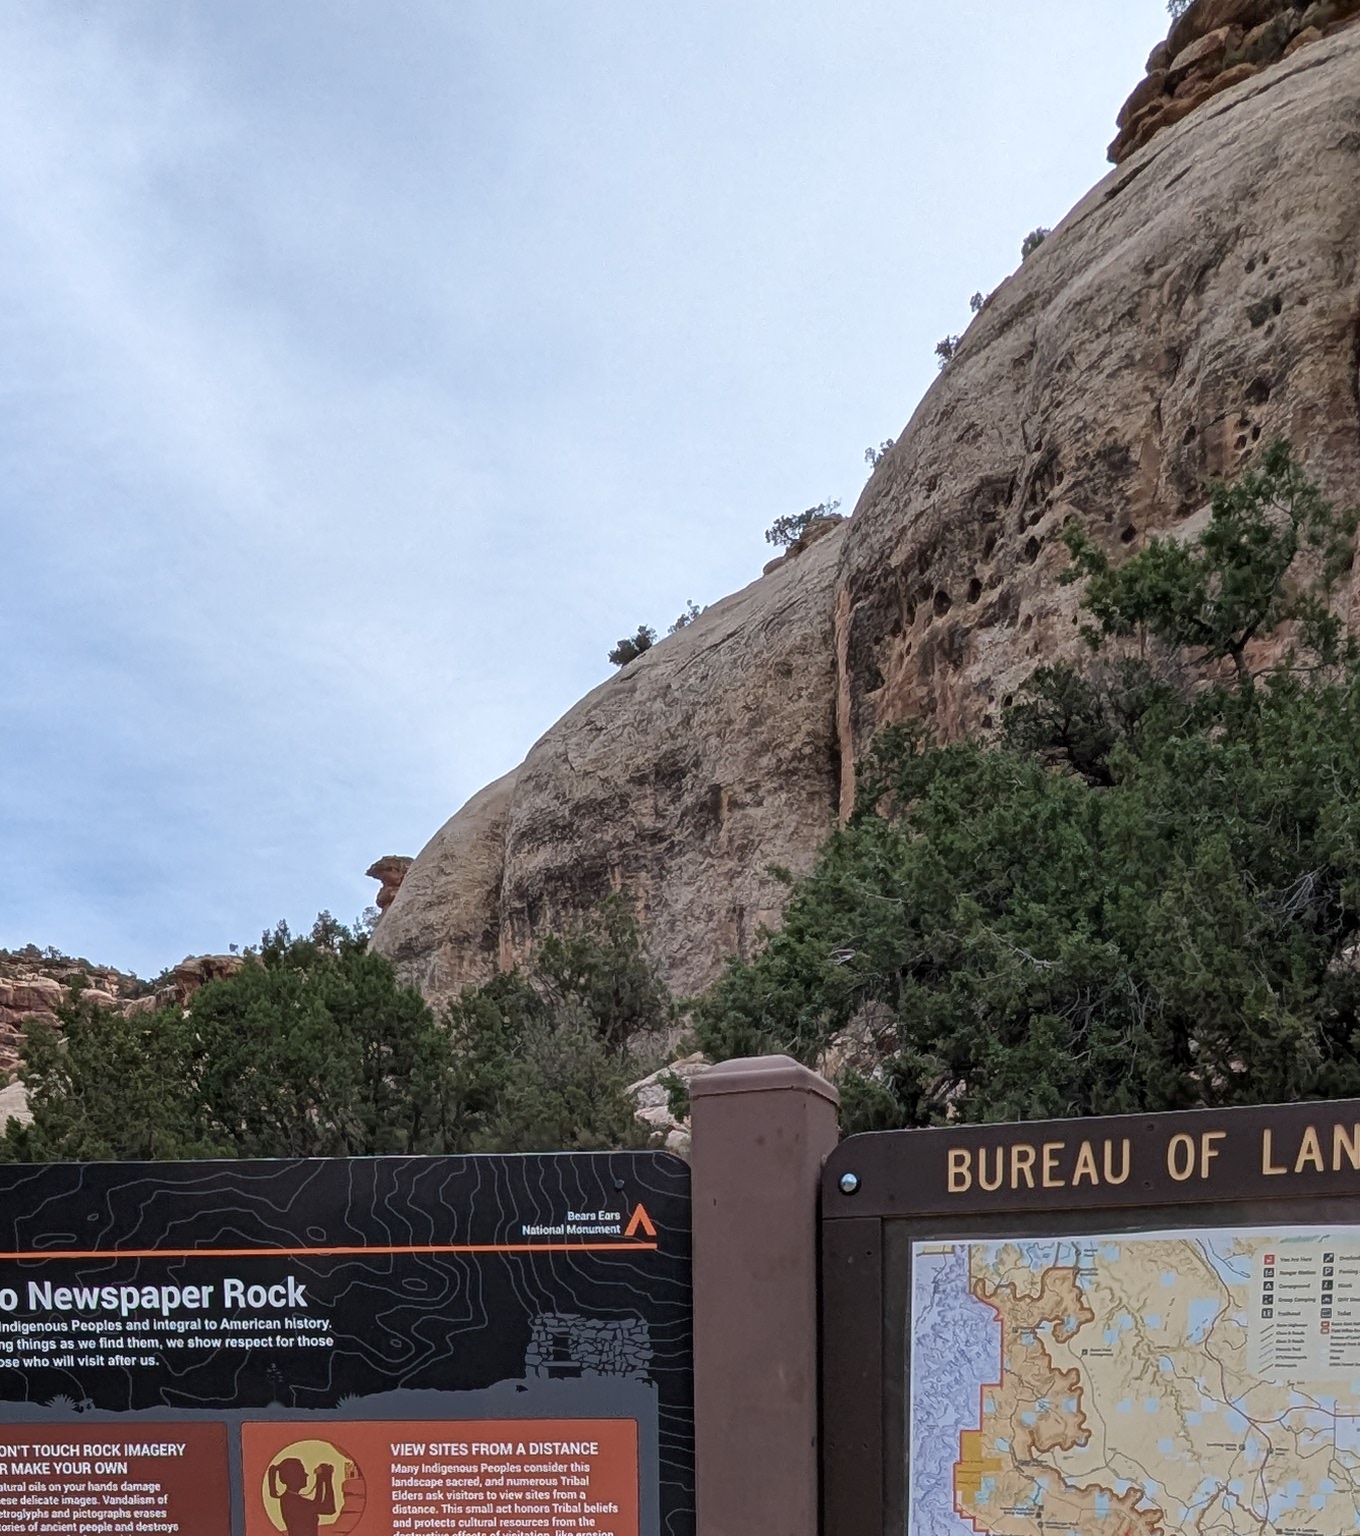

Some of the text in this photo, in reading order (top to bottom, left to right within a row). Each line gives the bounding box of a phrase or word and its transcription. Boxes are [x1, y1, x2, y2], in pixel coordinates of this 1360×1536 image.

[947, 1137, 1130, 1194] BUREAU
[1167, 1130, 1226, 1181] OF
[522, 1223, 620, 1235] National Monument
[27, 1280, 214, 1317] Newspaper
[223, 1275, 308, 1308] Rock
[71, 1319, 123, 1334] Peoples
[125, 1318, 150, 1331] and
[153, 1317, 201, 1333] integral
[204, 1318, 217, 1330] to
[219, 1317, 281, 1330] American
[284, 1316, 332, 1331] history.
[16, 1337, 57, 1352] things
[59, 1339, 74, 1349] as
[77, 1339, 96, 1349] we
[98, 1336, 124, 1348] find
[126, 1336, 163, 1350] them,
[165, 1338, 184, 1348] we
[187, 1335, 222, 1348] show
[224, 1335, 273, 1350] respect
[275, 1334, 294, 1347] for
[296, 1334, 334, 1347] those
[22, 1355, 50, 1367] who
[52, 1354, 74, 1367] will
[77, 1354, 105, 1366] visit
[107, 1354, 137, 1366] after
[139, 1356, 159, 1366] us.
[31, 1444, 80, 1457] TOUCH
[83, 1443, 121, 1456] ROCK
[123, 1443, 186, 1456] IMAGERY
[390, 1441, 598, 1456] VIEW SITES FROM A DISTANCE
[10, 1461, 51, 1475] MAKE
[52, 1461, 91, 1474] YOUR
[94, 1461, 127, 1474] OWN
[390, 1461, 590, 1475] Many Indigenous Peoples consider this
[28, 1481, 47, 1491] oils
[48, 1483, 61, 1491] on
[62, 1483, 86, 1494] your
[87, 1480, 118, 1491] hands
[120, 1480, 160, 1493] damage
